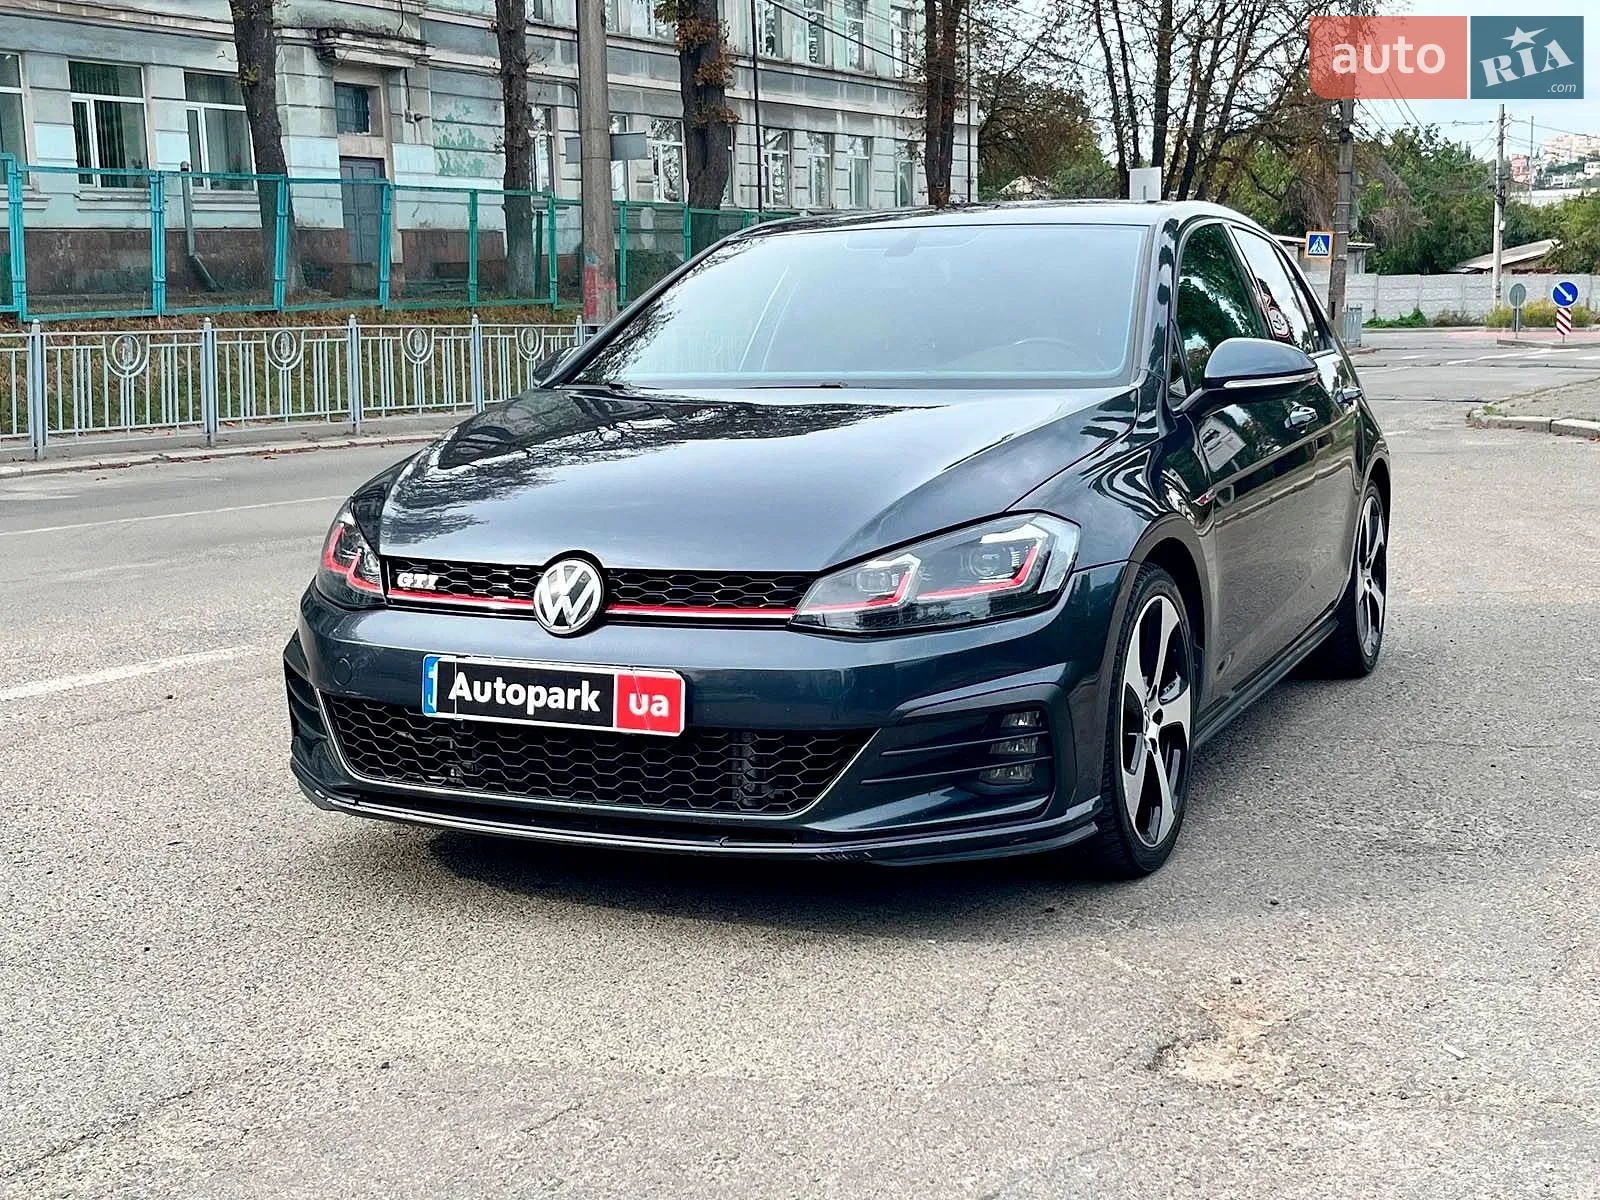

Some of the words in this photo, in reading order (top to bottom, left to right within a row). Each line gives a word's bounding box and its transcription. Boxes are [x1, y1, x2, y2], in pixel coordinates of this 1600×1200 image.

[396, 572, 439, 590] GTI
[447, 671, 601, 715] Autopark
[628, 691, 669, 717] ua
